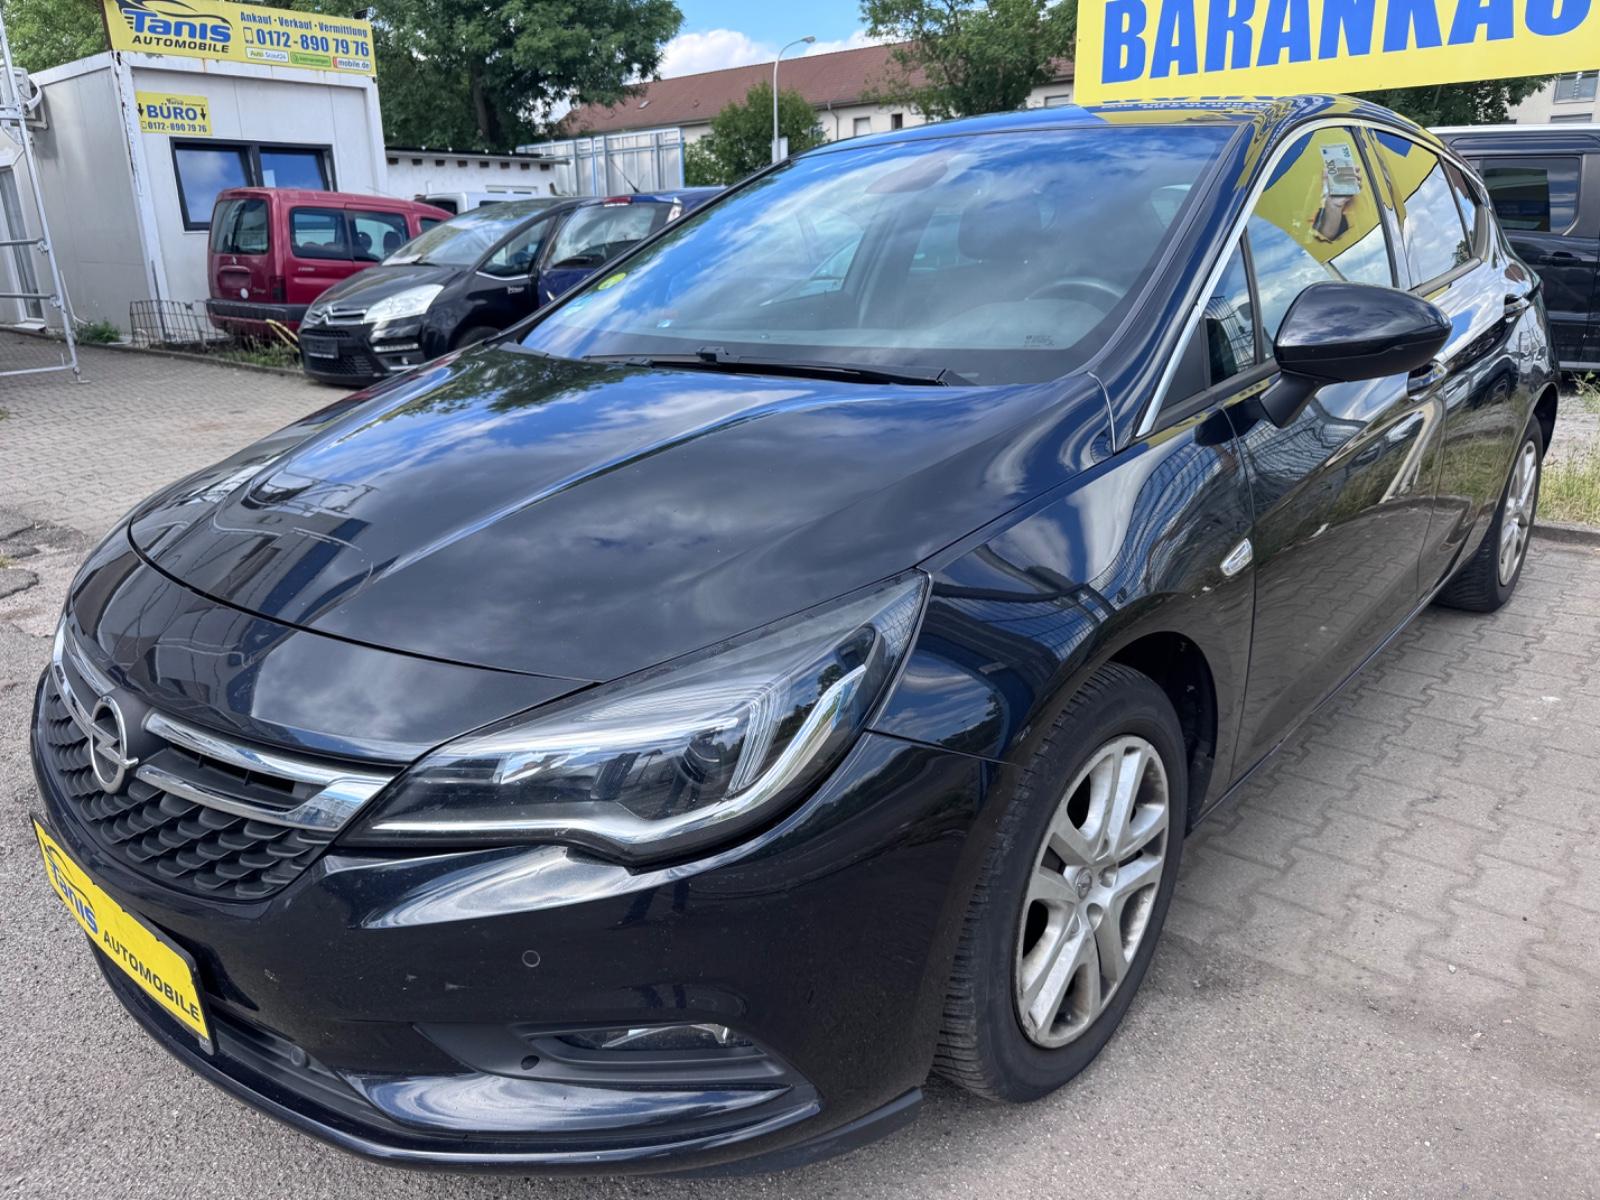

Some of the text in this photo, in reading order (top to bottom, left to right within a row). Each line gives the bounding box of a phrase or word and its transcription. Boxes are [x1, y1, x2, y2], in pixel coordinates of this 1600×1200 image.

[122, 8, 231, 43] Tanis
[240, 11, 368, 38] Ankauf Verkauf Vermittlung
[132, 34, 230, 54] AUTOMOBILE
[332, 38, 350, 55] 79
[352, 41, 370, 57] 76
[337, 59, 370, 70] mobile.de
[146, 102, 198, 121] BÜRO
[187, 123, 197, 132] 79
[103, 929, 201, 1022] AUTOMOBILE
